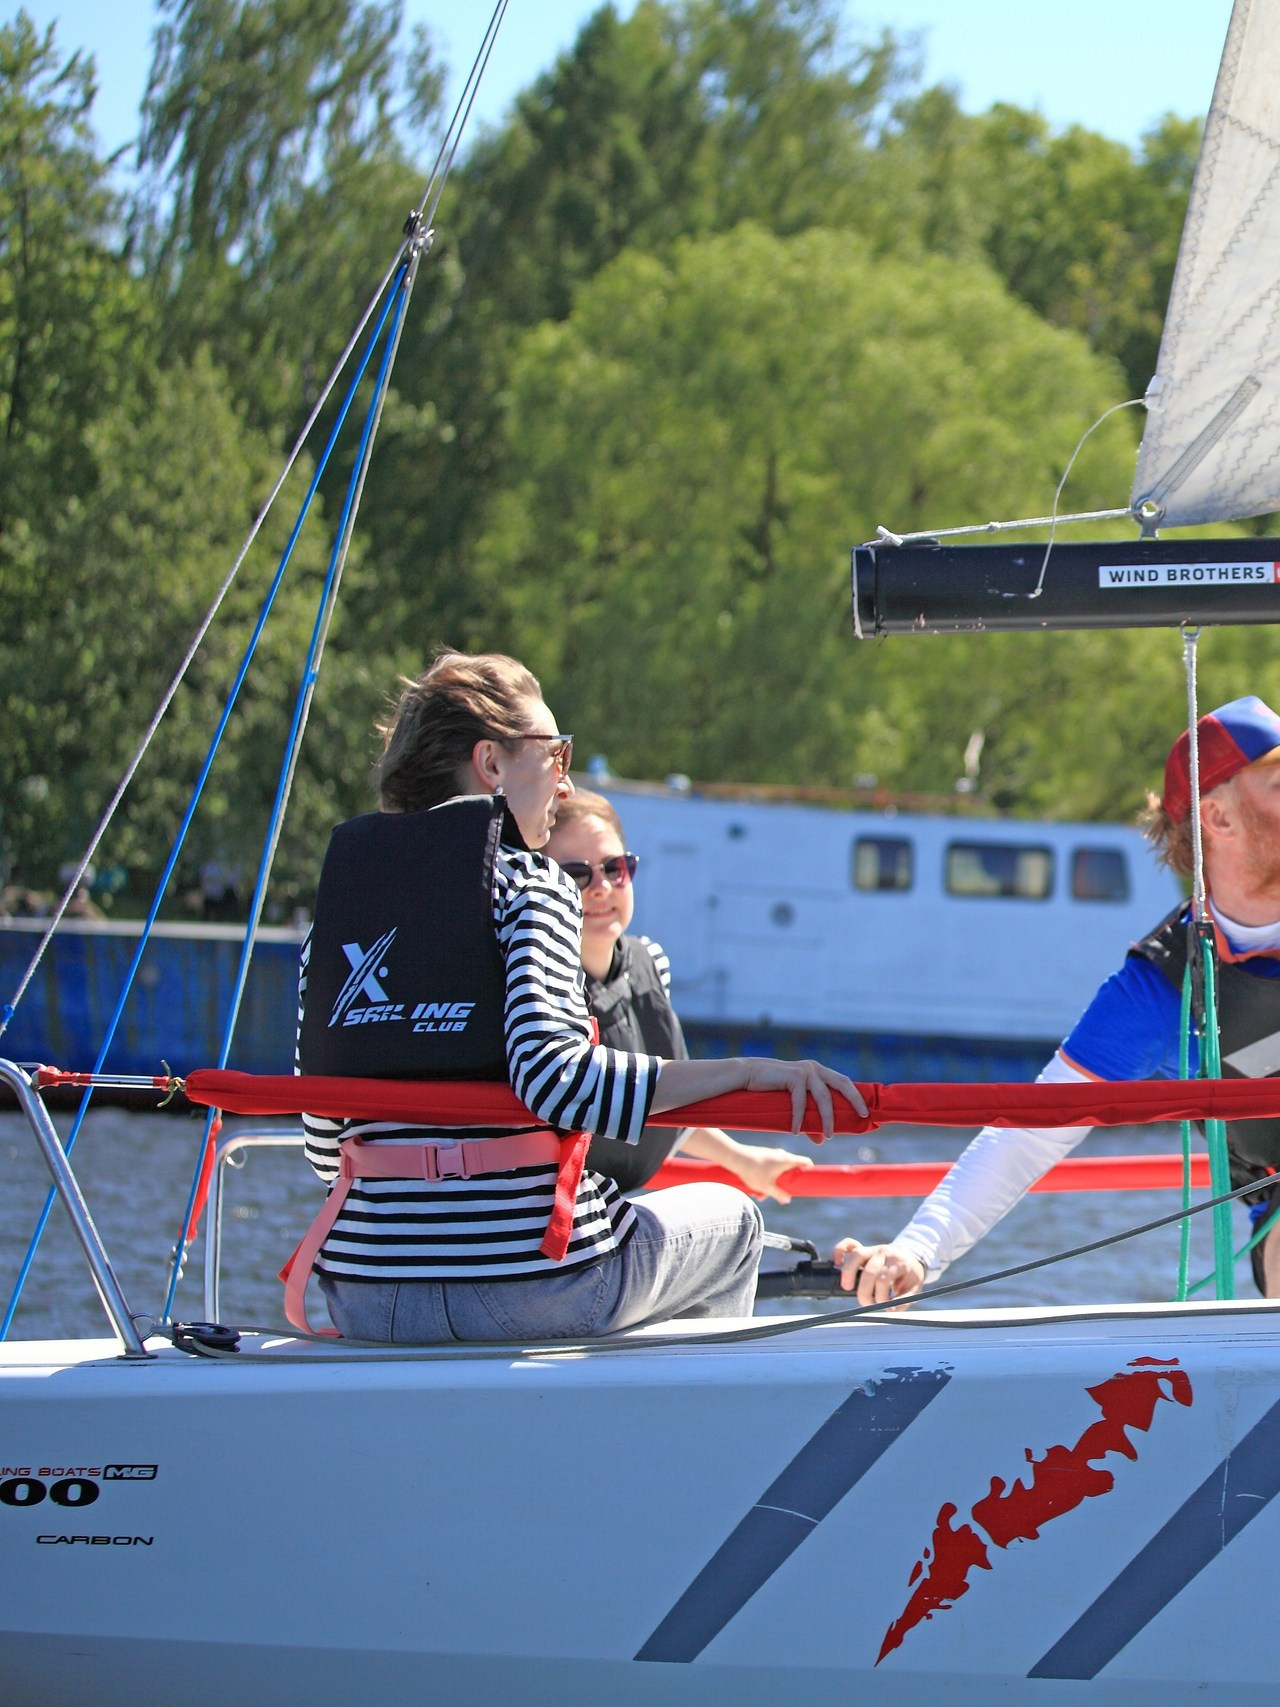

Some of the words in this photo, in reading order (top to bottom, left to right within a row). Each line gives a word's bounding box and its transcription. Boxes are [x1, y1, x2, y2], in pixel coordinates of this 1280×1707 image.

[1109, 569, 1159, 583] WIND
[1167, 566, 1266, 581] BROTHERS
[412, 1021, 468, 1033] CLUB
[0, 1467, 31, 1476] ING
[38, 1467, 101, 1477] BOATS
[105, 1466, 156, 1479] MG
[0, 1477, 100, 1507] 00
[36, 1535, 154, 1545] CARBON
